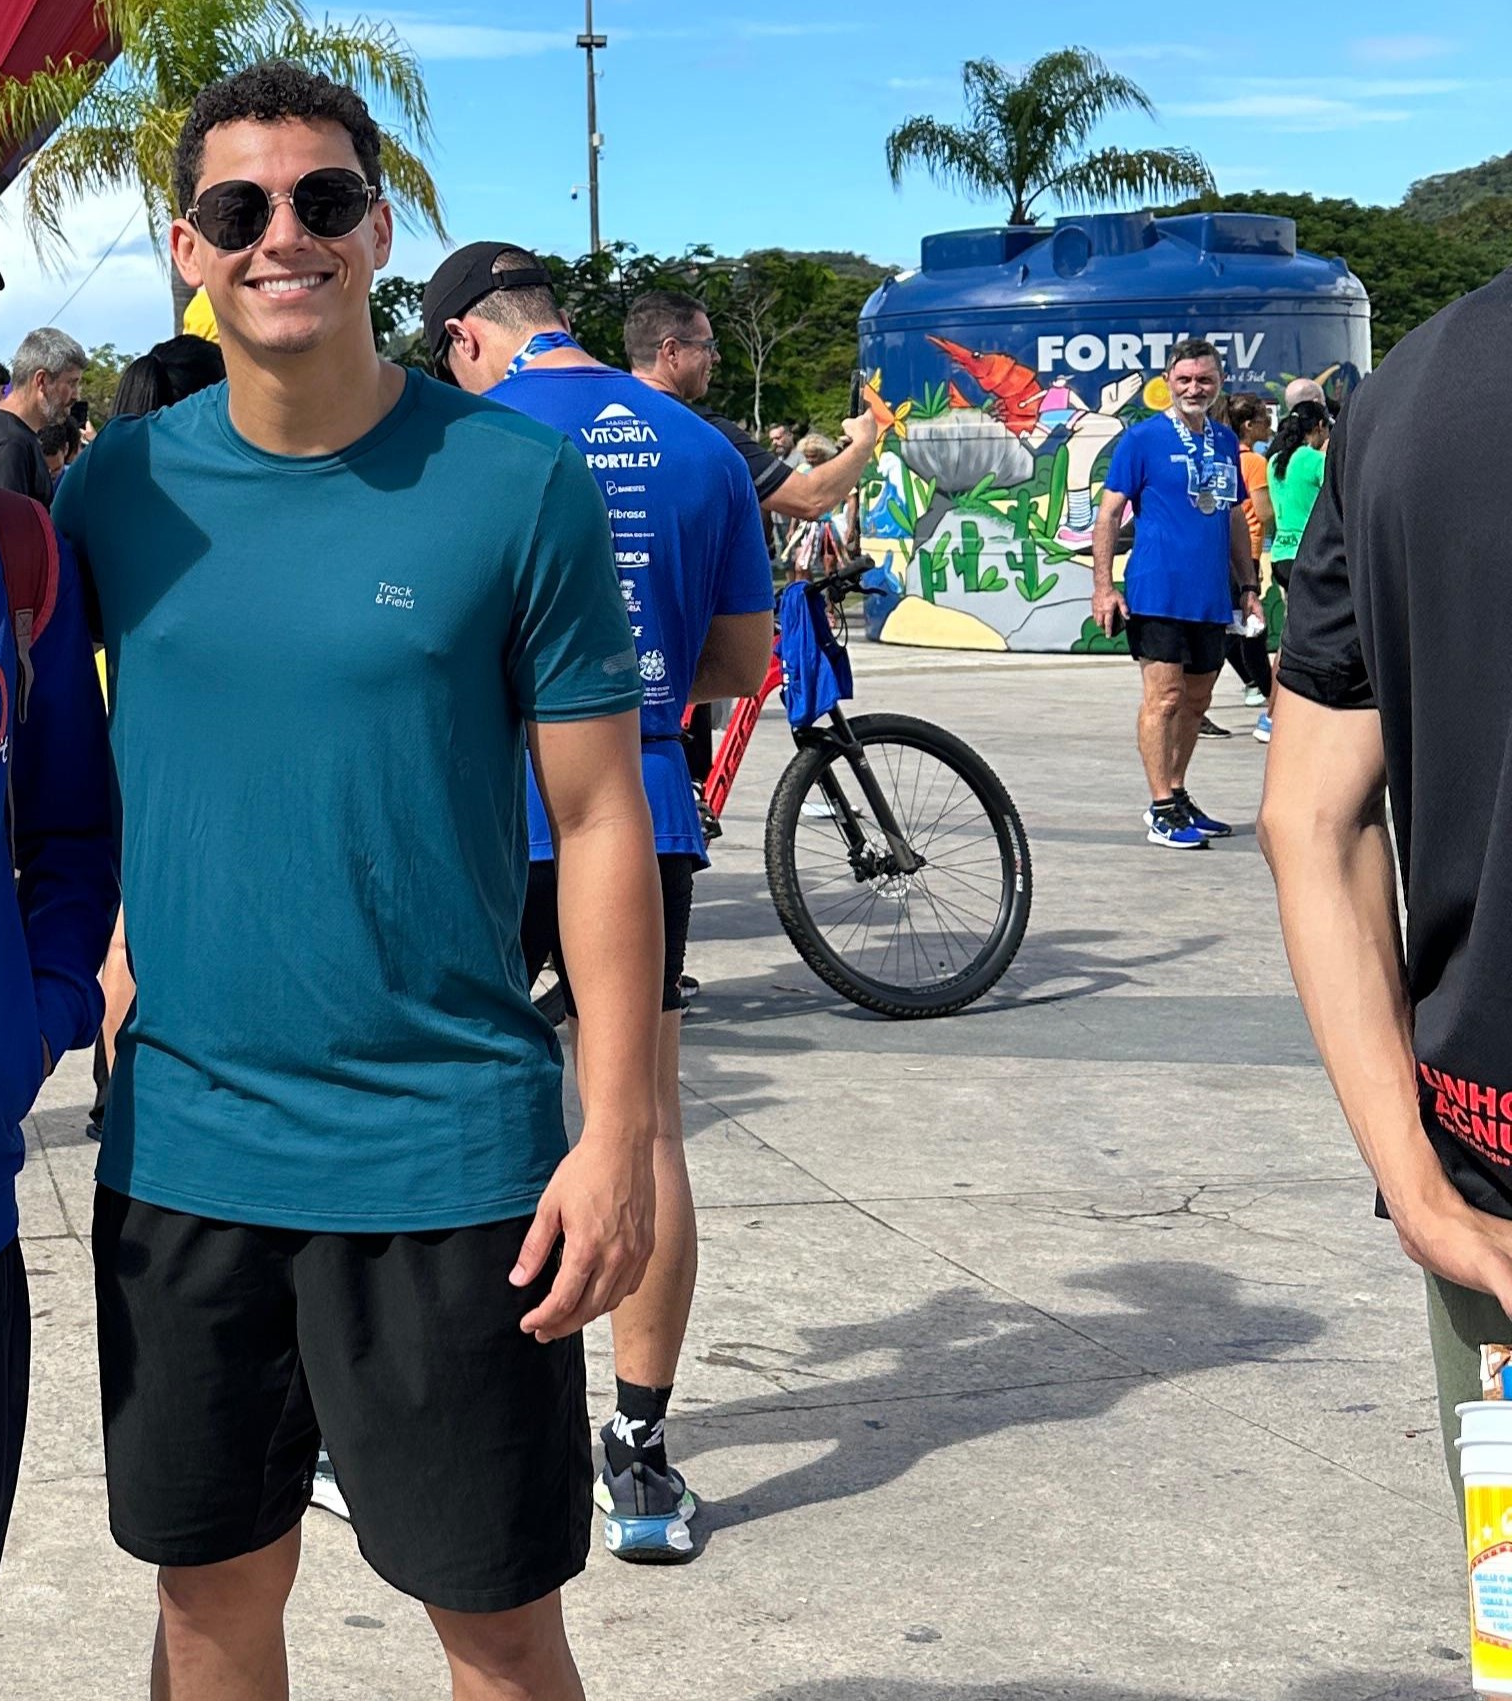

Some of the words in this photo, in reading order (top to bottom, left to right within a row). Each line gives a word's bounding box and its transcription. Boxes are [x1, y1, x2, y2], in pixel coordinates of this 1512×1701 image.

[1037, 332, 1265, 372] FORTEV
[585, 452, 661, 469] FORTLEV
[378, 581, 413, 598] Track
[375, 593, 384, 604] &
[384, 594, 415, 609] Field
